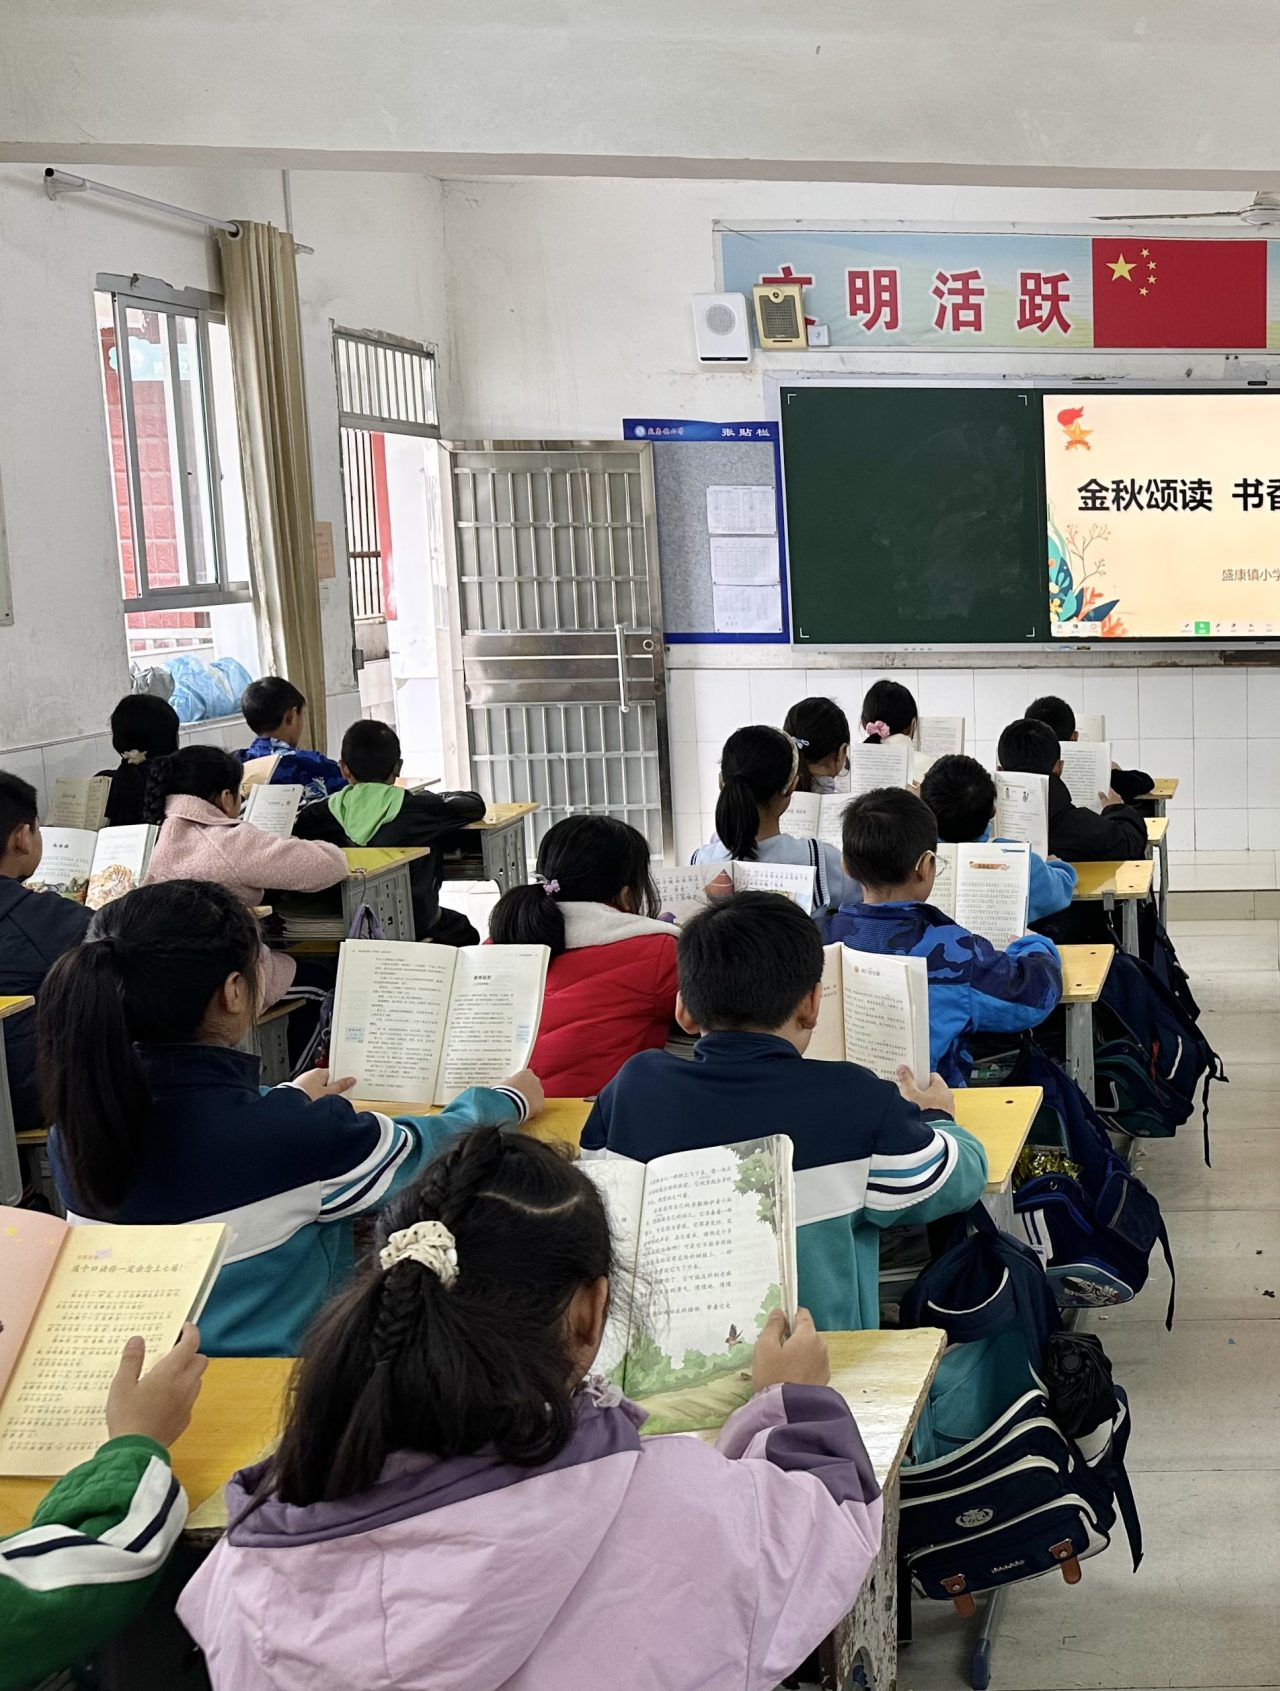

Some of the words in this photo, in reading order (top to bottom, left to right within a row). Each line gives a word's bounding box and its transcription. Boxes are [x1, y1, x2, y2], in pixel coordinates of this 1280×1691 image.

[721, 428, 771, 437] 张贴栏
[1077, 478, 1213, 512] 金秋颂读
